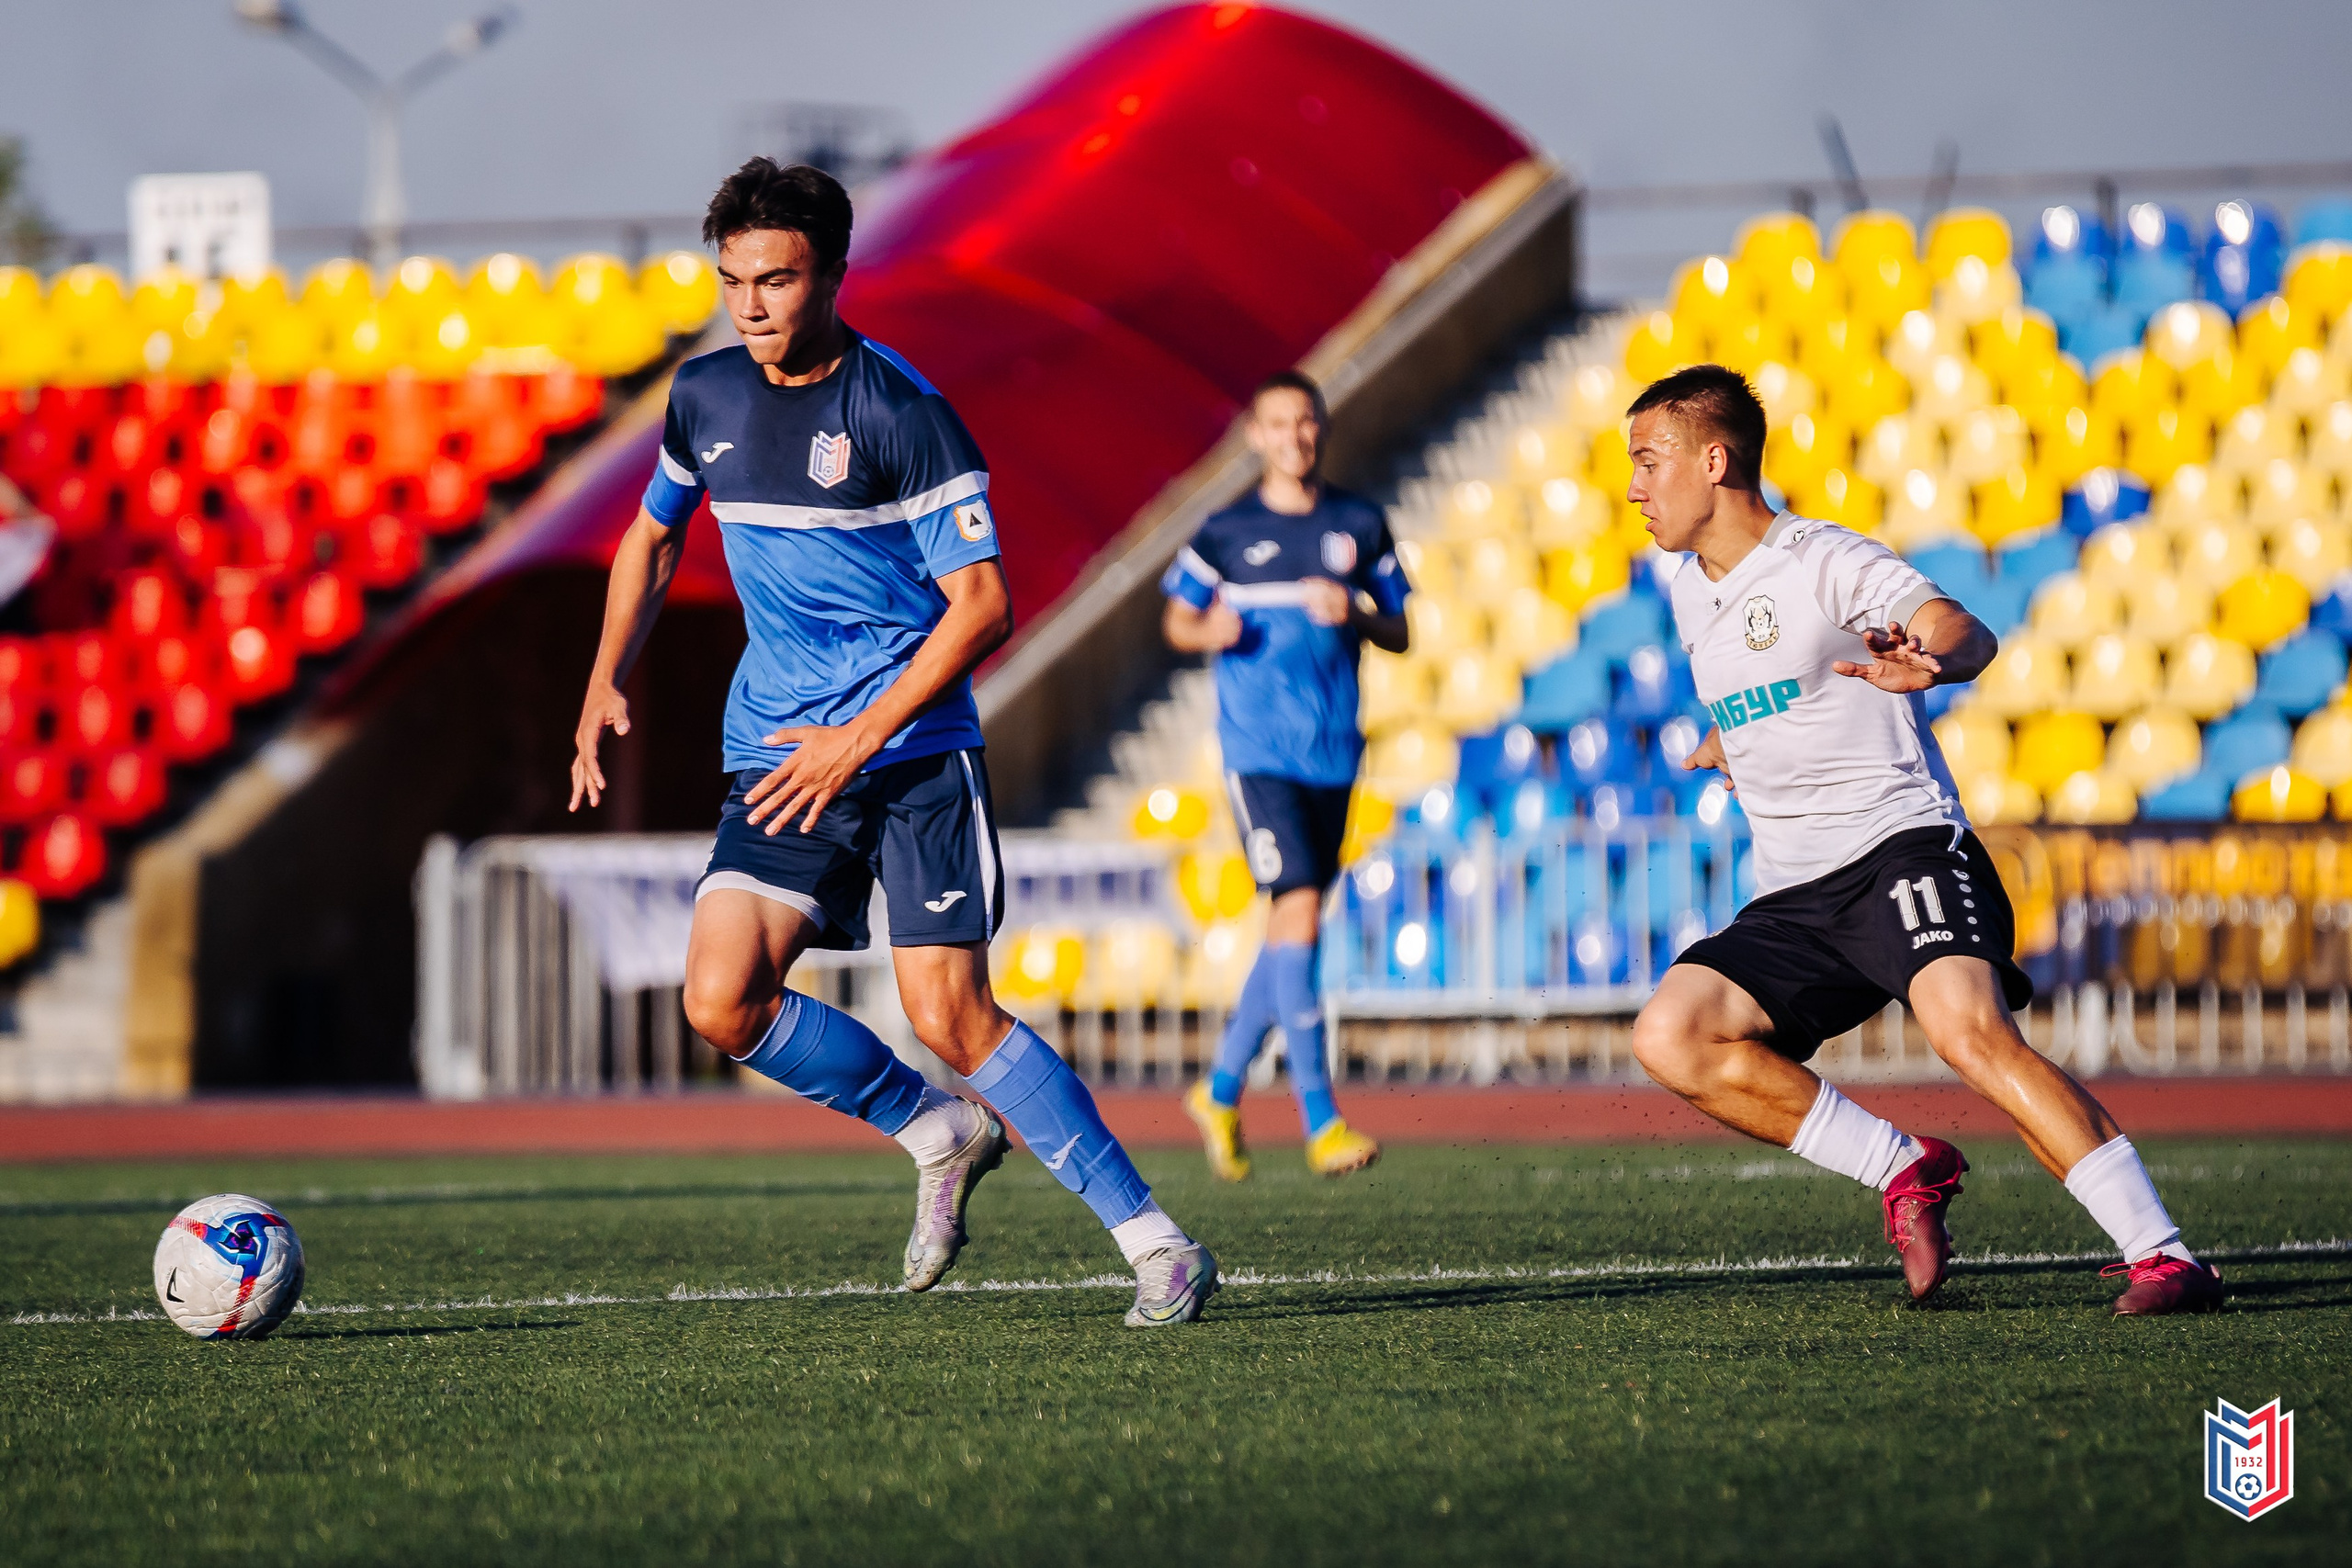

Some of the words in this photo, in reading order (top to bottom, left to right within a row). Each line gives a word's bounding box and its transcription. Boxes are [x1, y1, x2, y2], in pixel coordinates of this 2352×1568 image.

[1709, 678, 1802, 733] ИБУР
[1889, 876, 1946, 931] 11
[1913, 931, 1954, 949] JAKO
